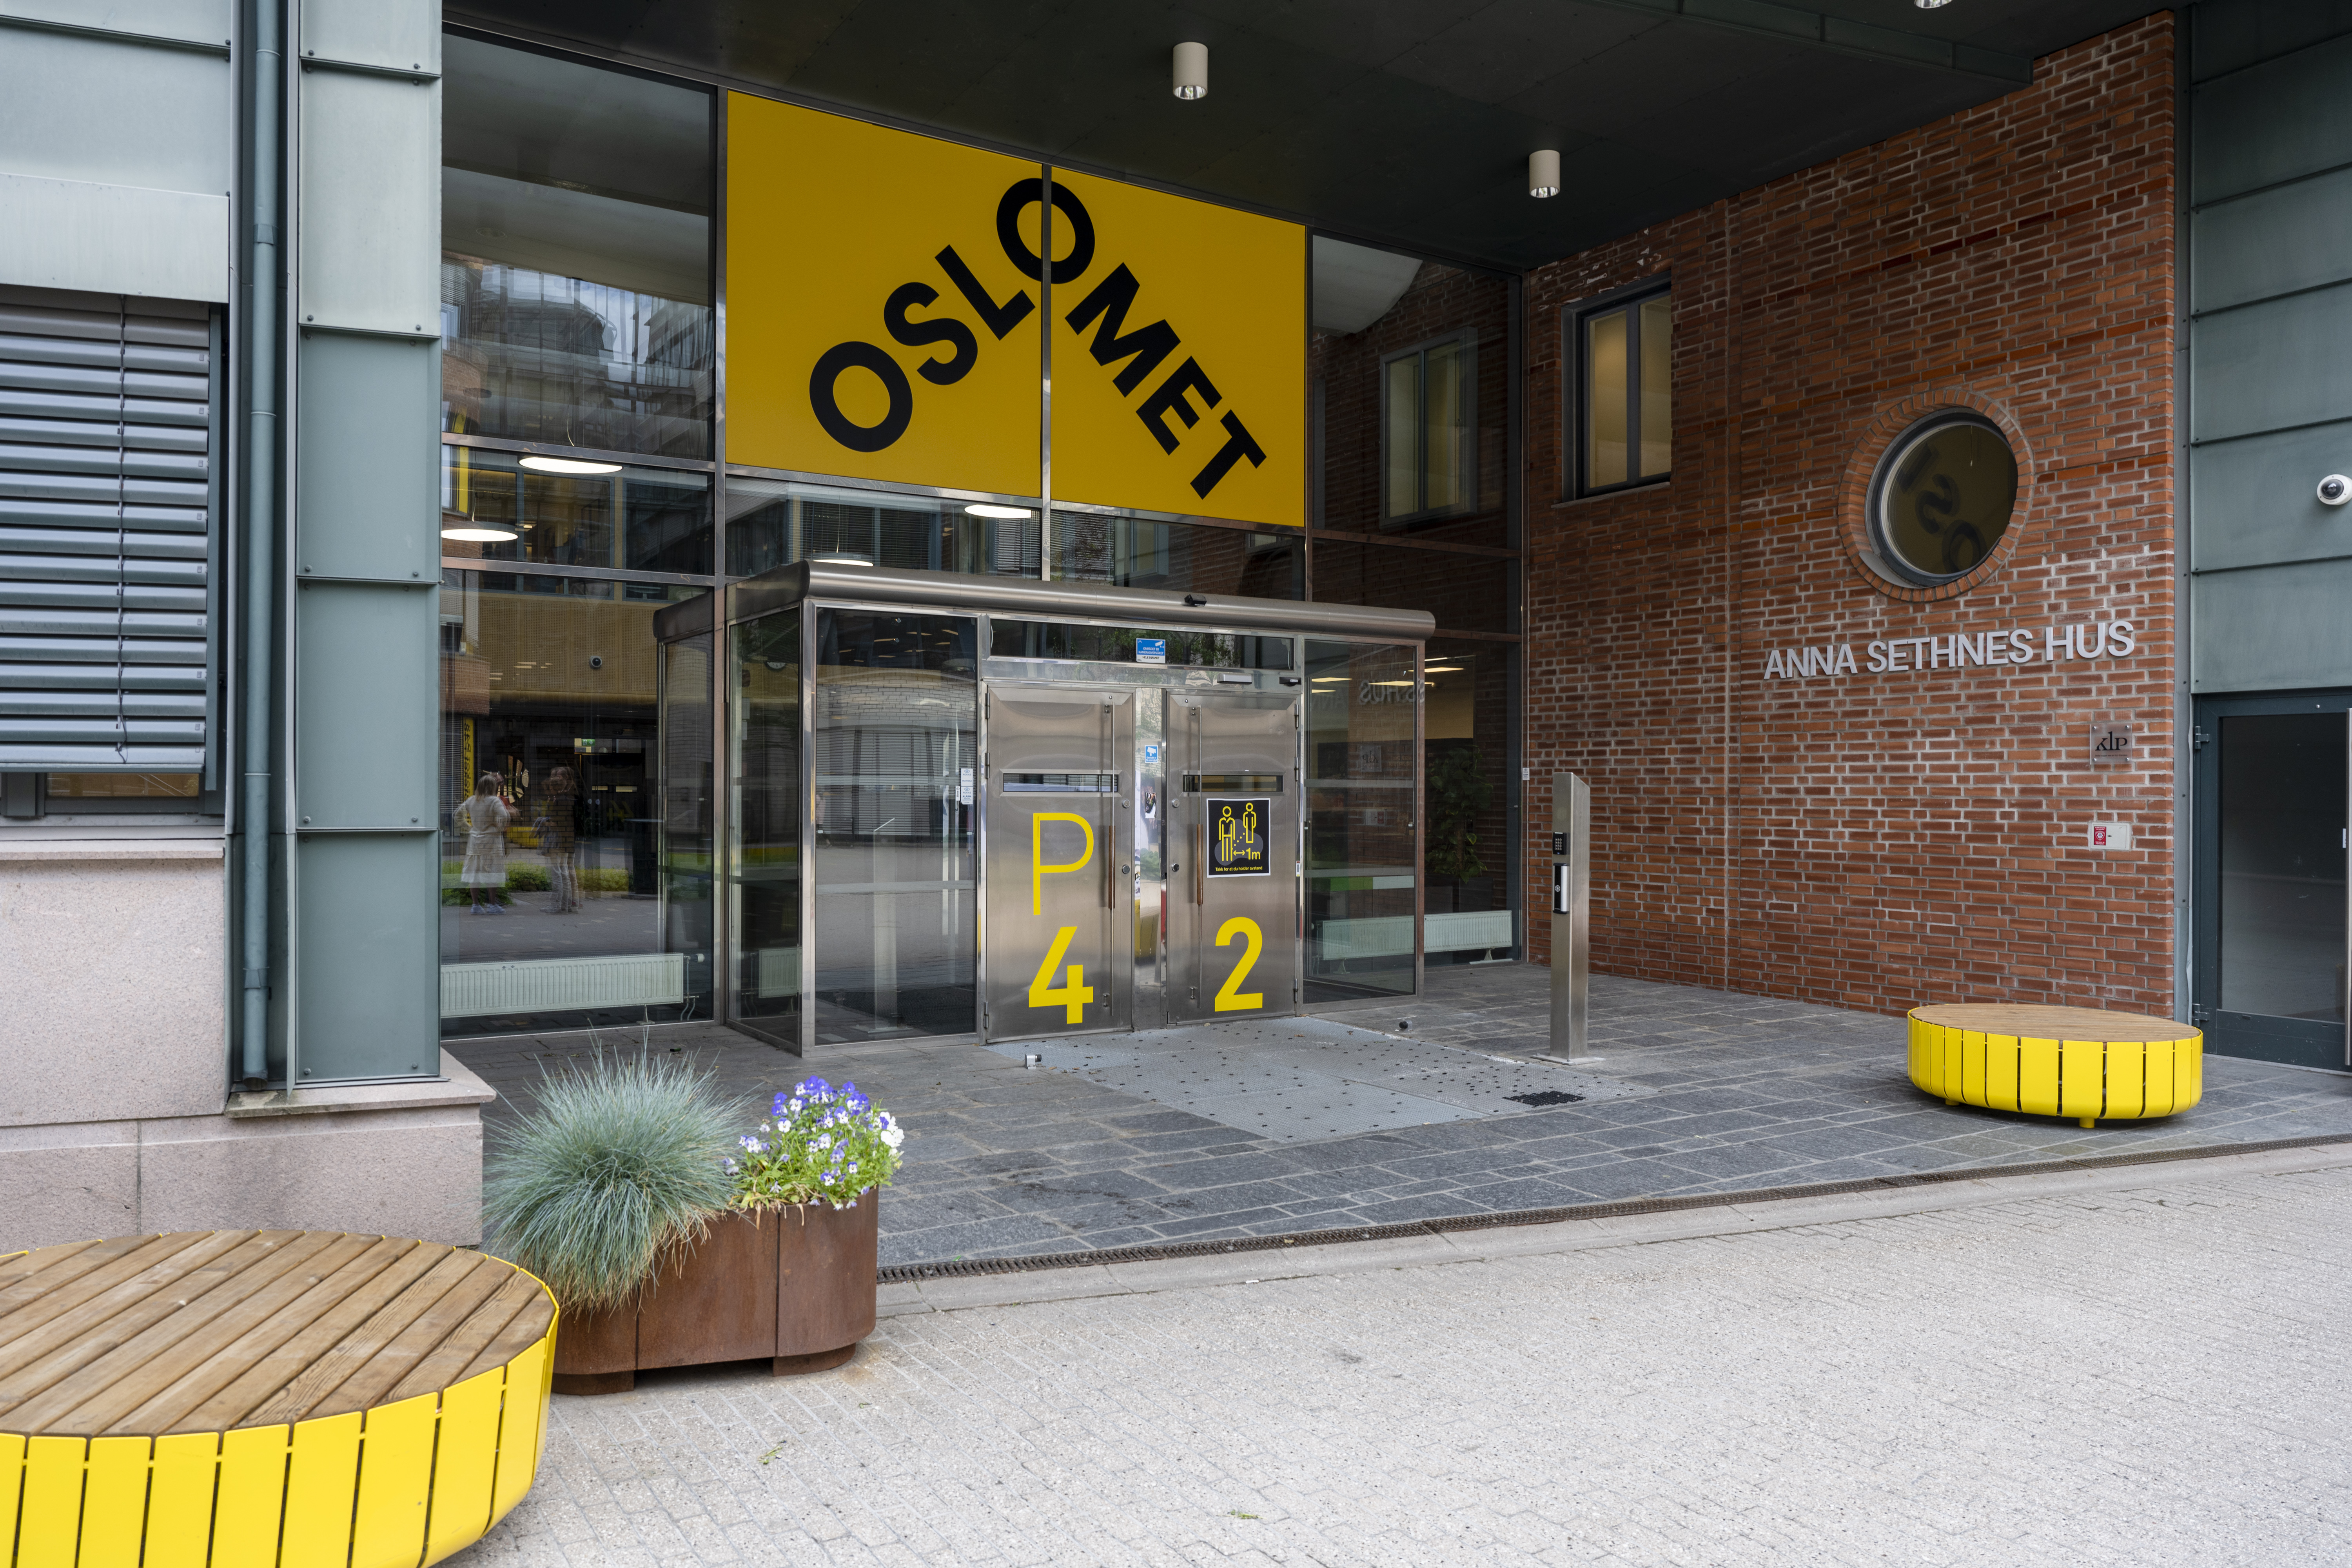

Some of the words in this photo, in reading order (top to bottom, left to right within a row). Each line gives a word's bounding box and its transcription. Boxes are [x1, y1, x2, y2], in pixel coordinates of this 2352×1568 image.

[809, 178, 1267, 500] OSLOMET
[1763, 643, 1858, 680] ANNA
[1867, 628, 2034, 673] SETHNES
[2045, 620, 2135, 661] HUS
[1033, 813, 1094, 915] P
[1246, 848, 1261, 860] 1m
[1029, 926, 1093, 1024] 4
[1215, 916, 1263, 1012] 2
